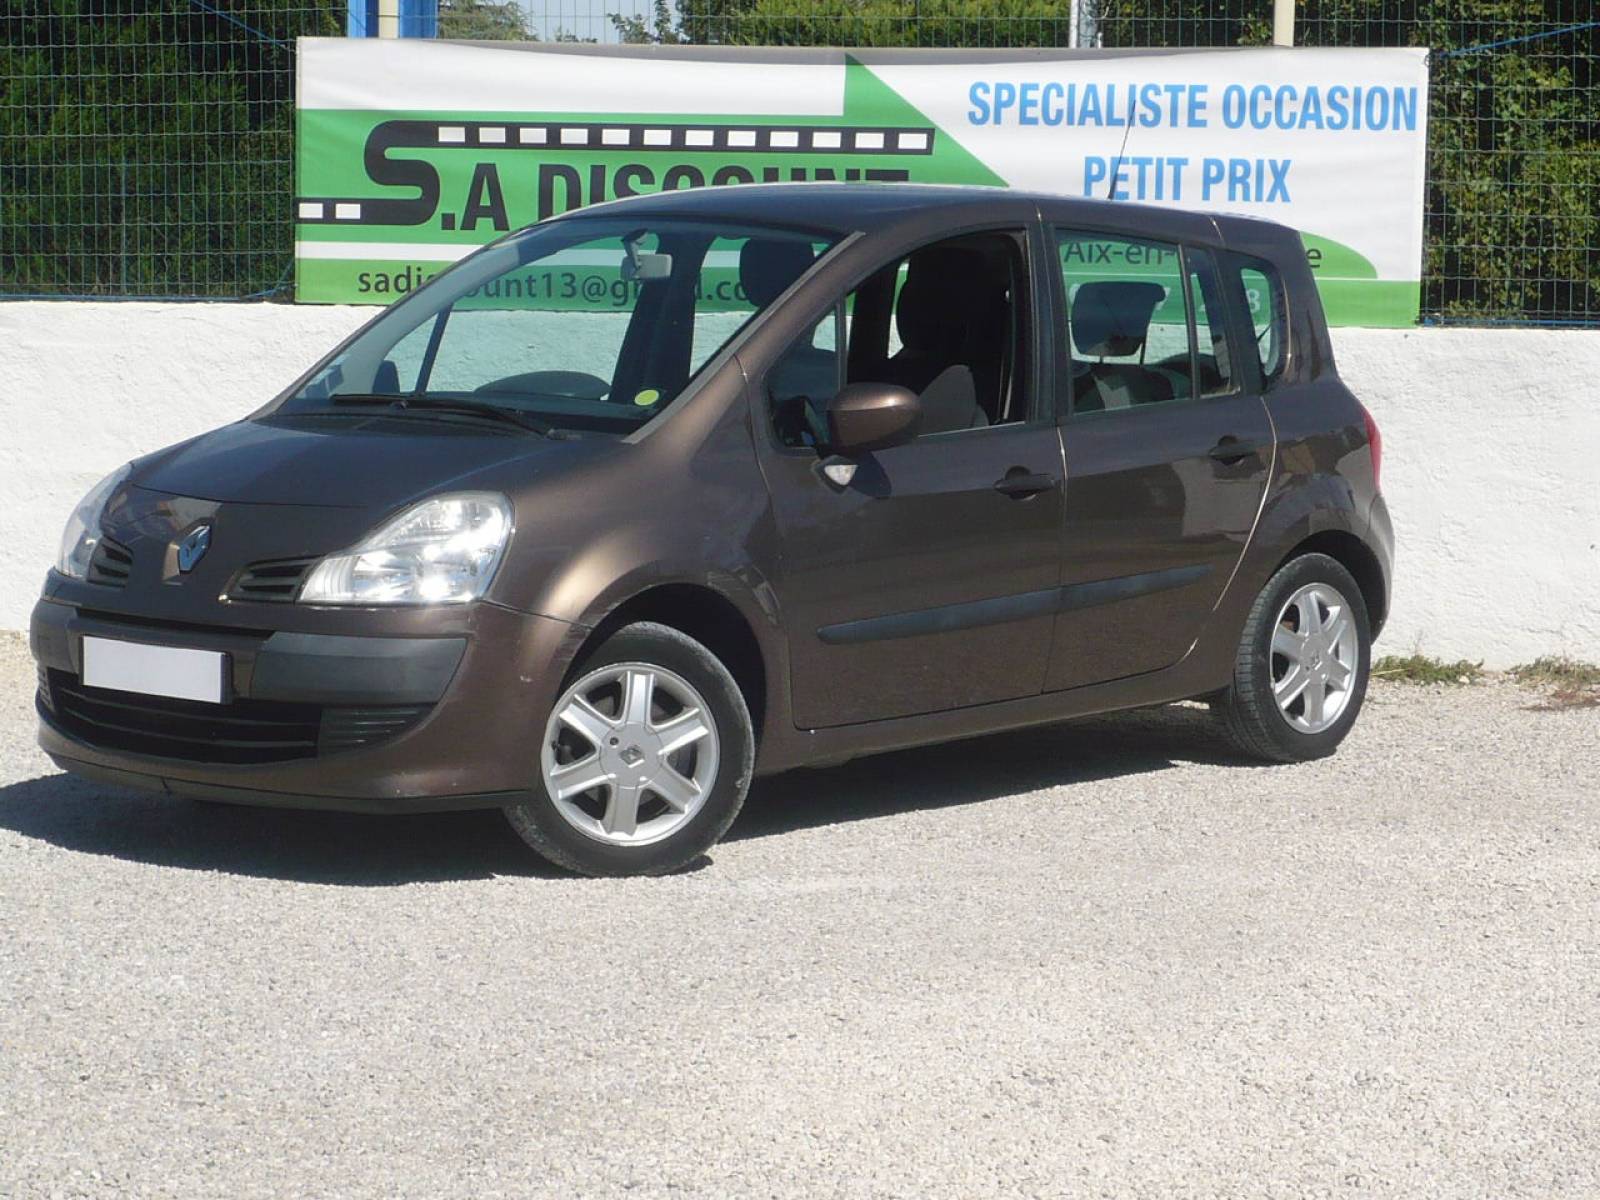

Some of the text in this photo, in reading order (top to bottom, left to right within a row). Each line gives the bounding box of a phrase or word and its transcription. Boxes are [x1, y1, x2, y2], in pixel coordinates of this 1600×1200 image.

[967, 81, 1417, 131] SPECIALISTE OCCASION
[1083, 156, 1292, 203] PETIT PRIX
